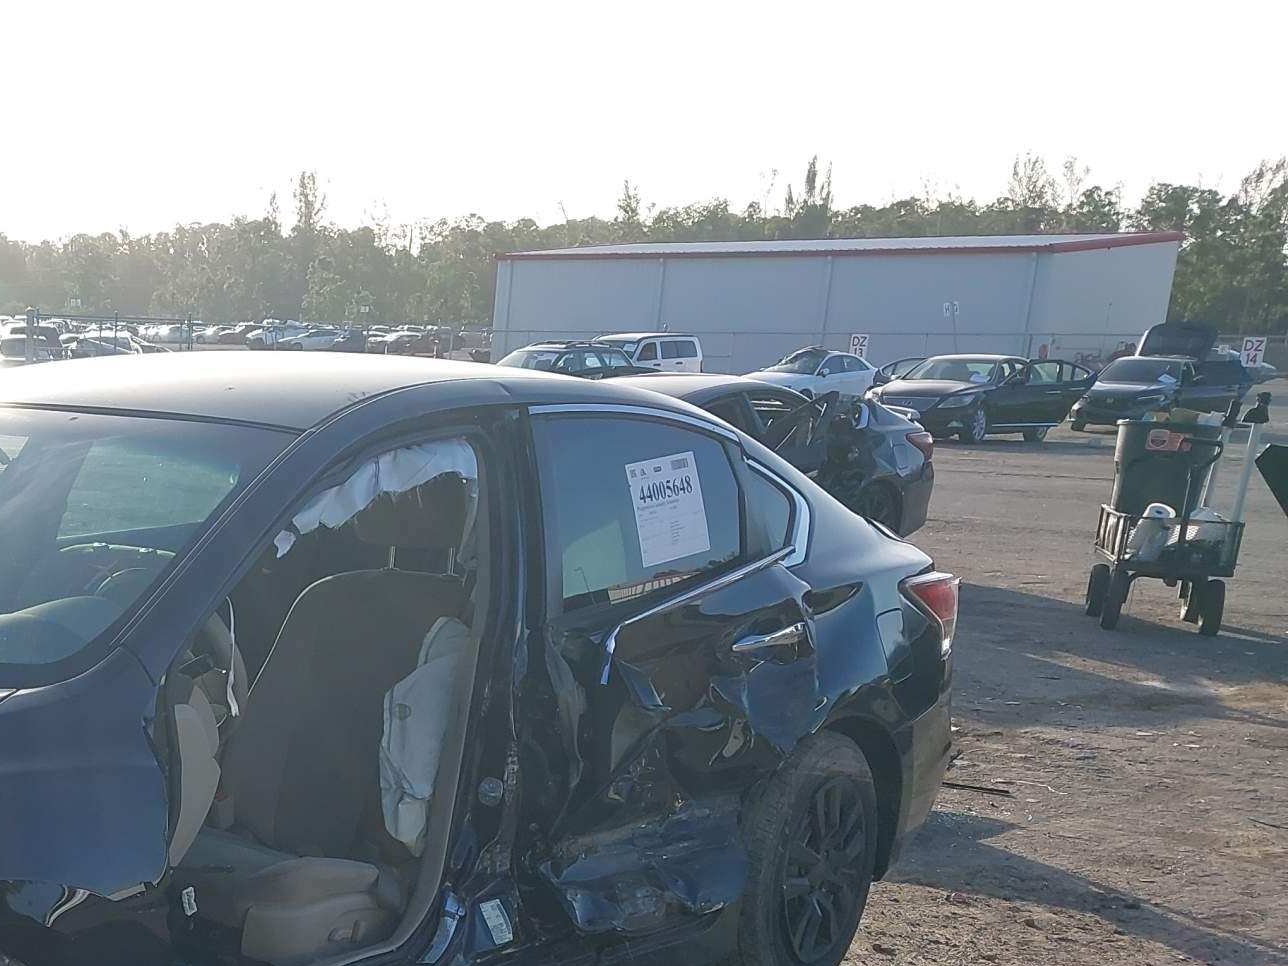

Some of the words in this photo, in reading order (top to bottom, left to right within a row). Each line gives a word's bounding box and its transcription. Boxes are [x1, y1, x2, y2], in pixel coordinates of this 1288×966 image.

[852, 336, 867, 347] DZ
[1244, 340, 1264, 351] DZ
[854, 347, 863, 358] 13
[1247, 353, 1258, 365] 14
[639, 474, 693, 504] 44005648
